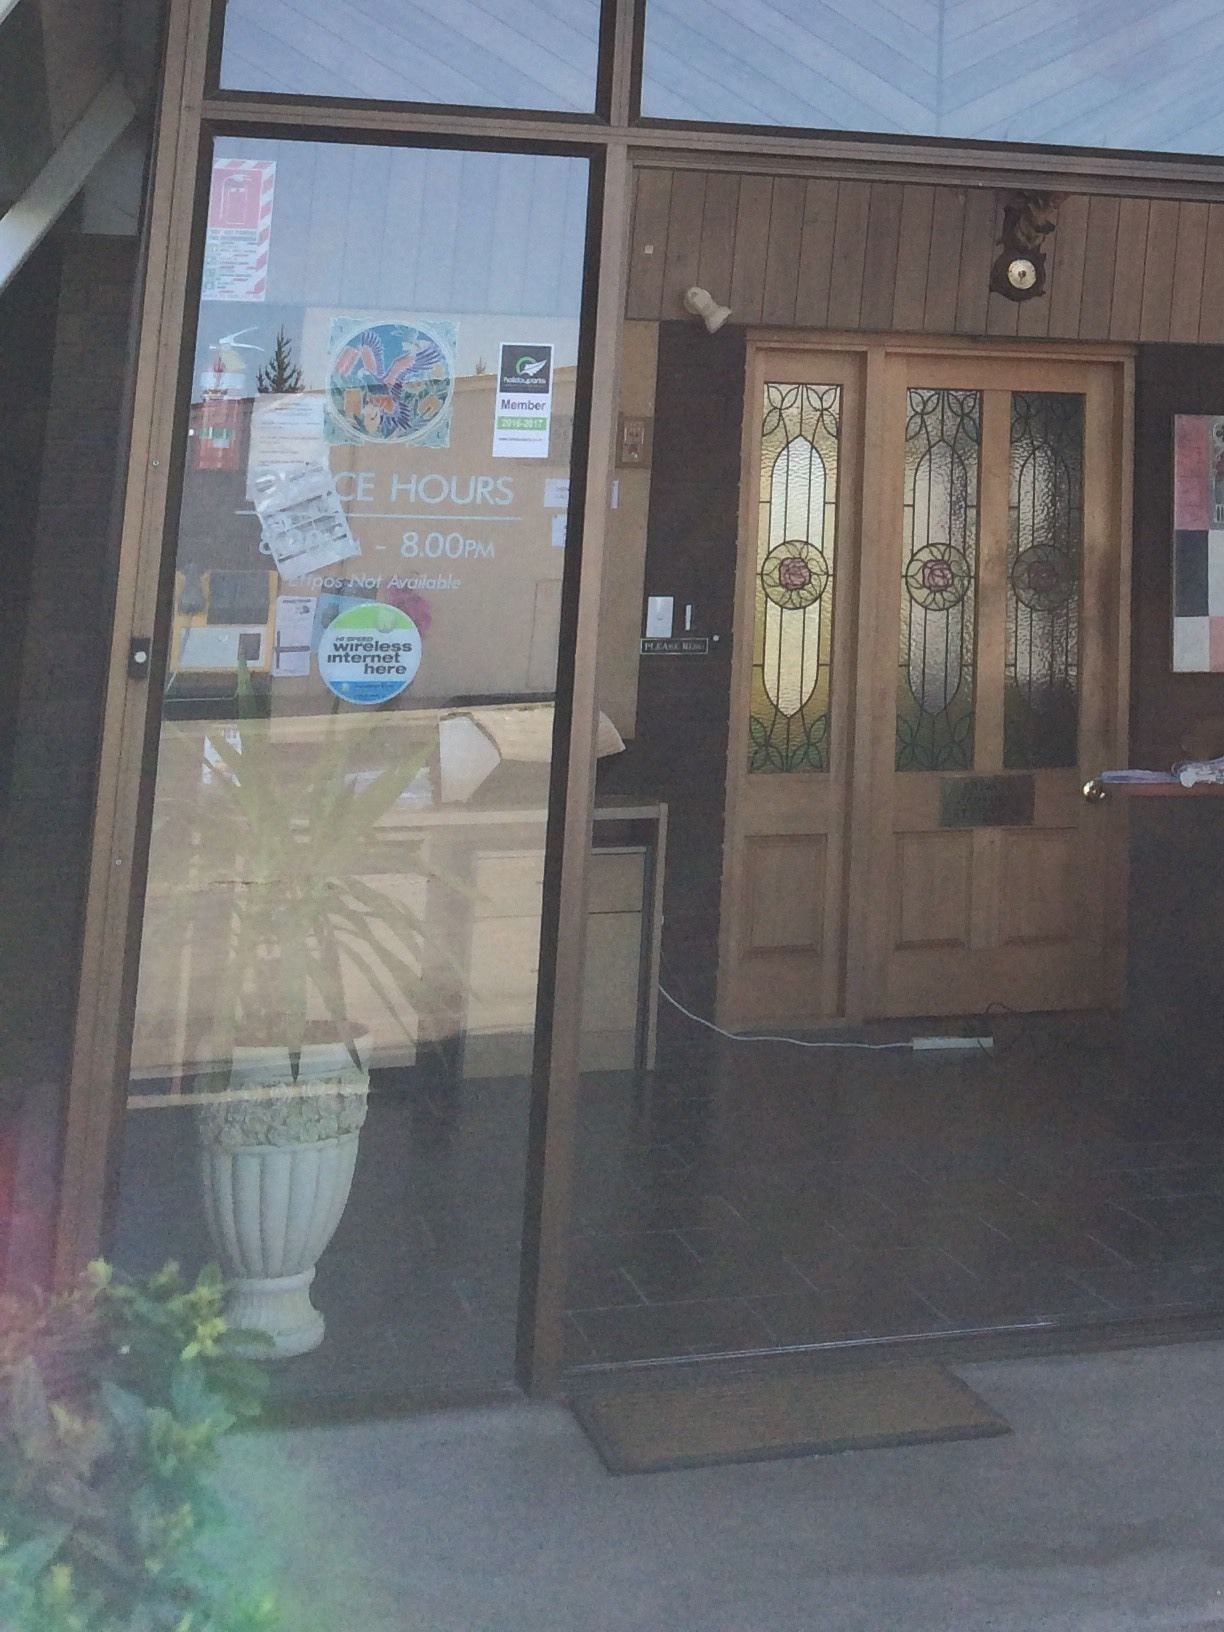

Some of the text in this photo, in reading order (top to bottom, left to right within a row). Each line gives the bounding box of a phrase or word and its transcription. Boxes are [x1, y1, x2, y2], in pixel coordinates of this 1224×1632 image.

[500, 399, 546, 410] Member
[390, 472, 514, 506] HOURS
[402, 531, 495, 558] 8.00PM
[347, 573, 384, 589] Not
[388, 573, 462, 589] Available
[333, 641, 413, 652] wireless
[327, 652, 401, 663] internet
[364, 663, 407, 674] here
